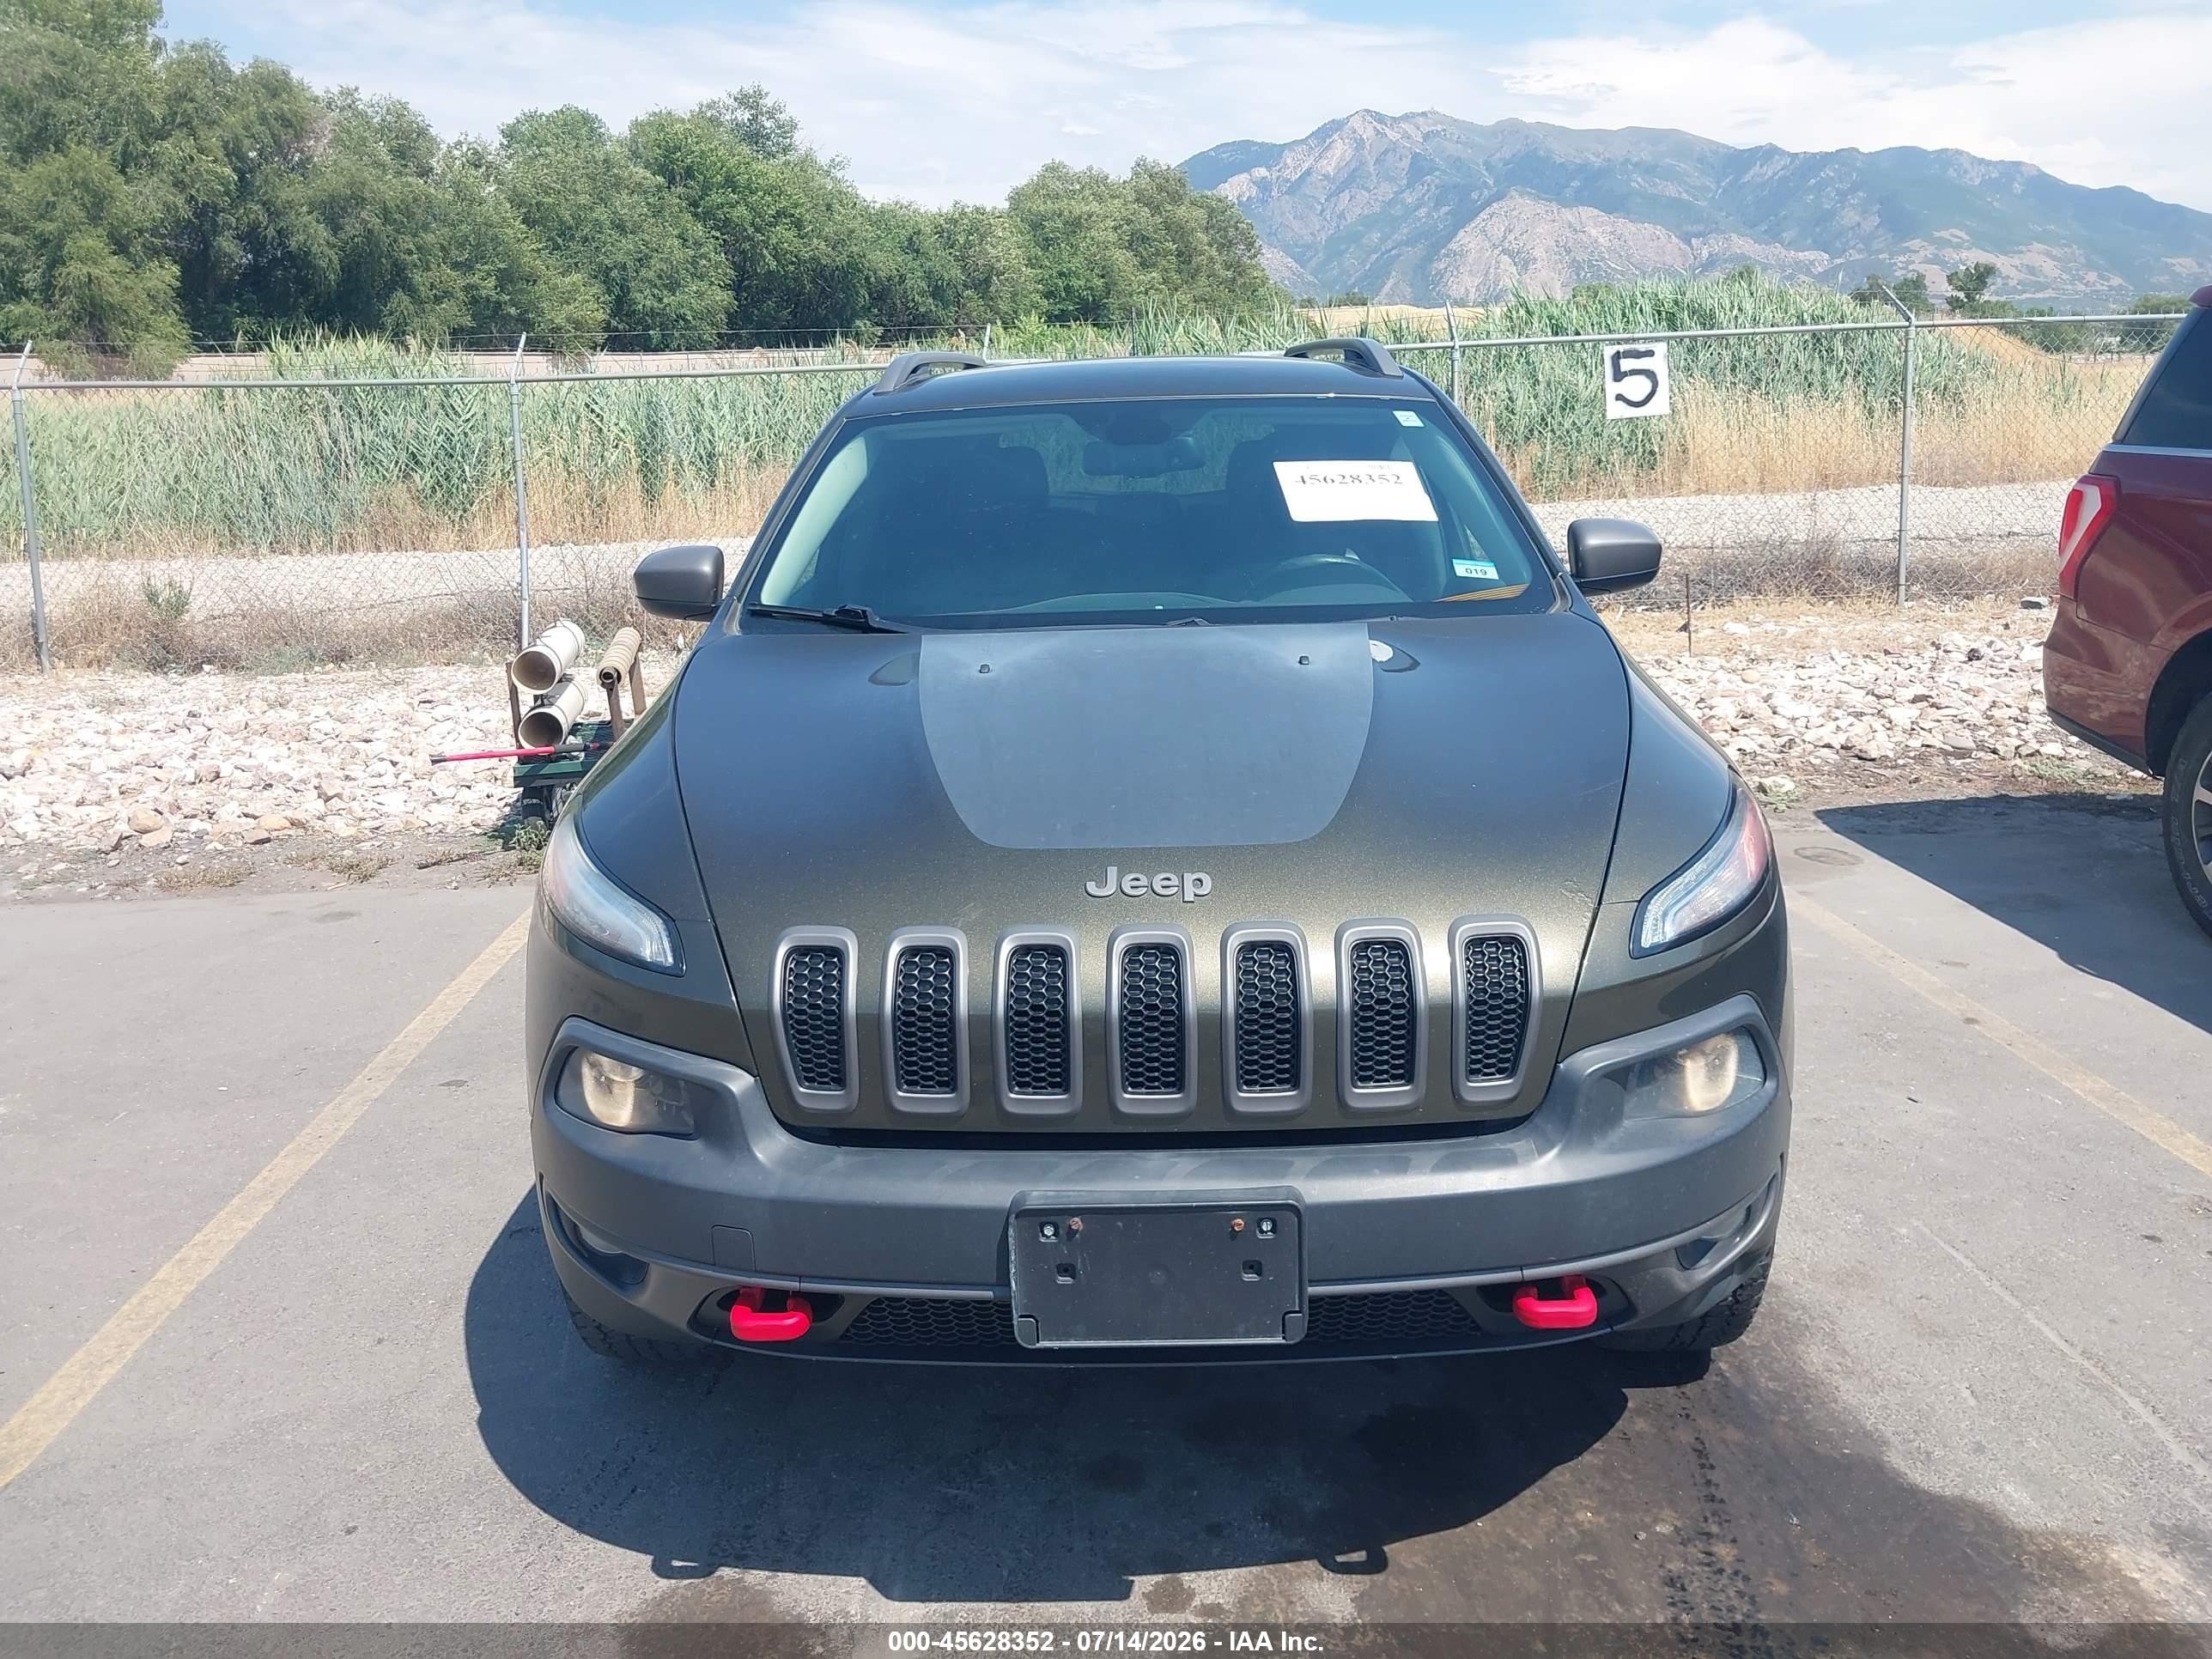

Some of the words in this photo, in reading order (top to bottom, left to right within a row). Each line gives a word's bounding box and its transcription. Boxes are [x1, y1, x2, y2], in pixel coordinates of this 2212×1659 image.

[1611, 349, 1659, 408] 5
[1295, 473, 1404, 486] 45628352
[1085, 866, 1212, 902] Jeep
